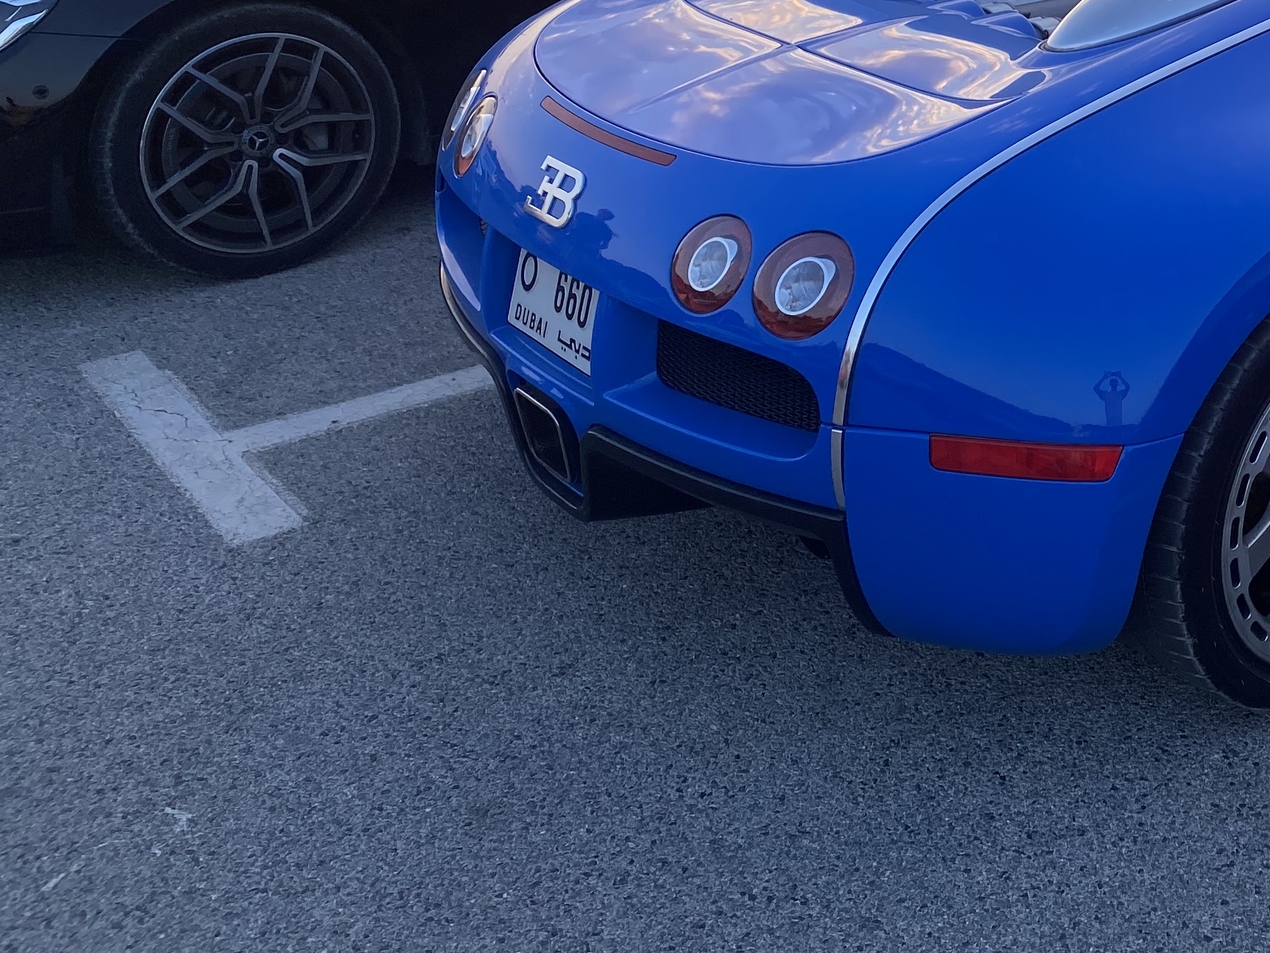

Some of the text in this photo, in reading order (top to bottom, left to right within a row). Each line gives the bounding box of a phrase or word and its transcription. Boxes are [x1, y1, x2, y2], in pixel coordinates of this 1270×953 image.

[554, 270, 593, 328] 660
[514, 303, 548, 338] DUBAI
[557, 330, 591, 361] دبي
